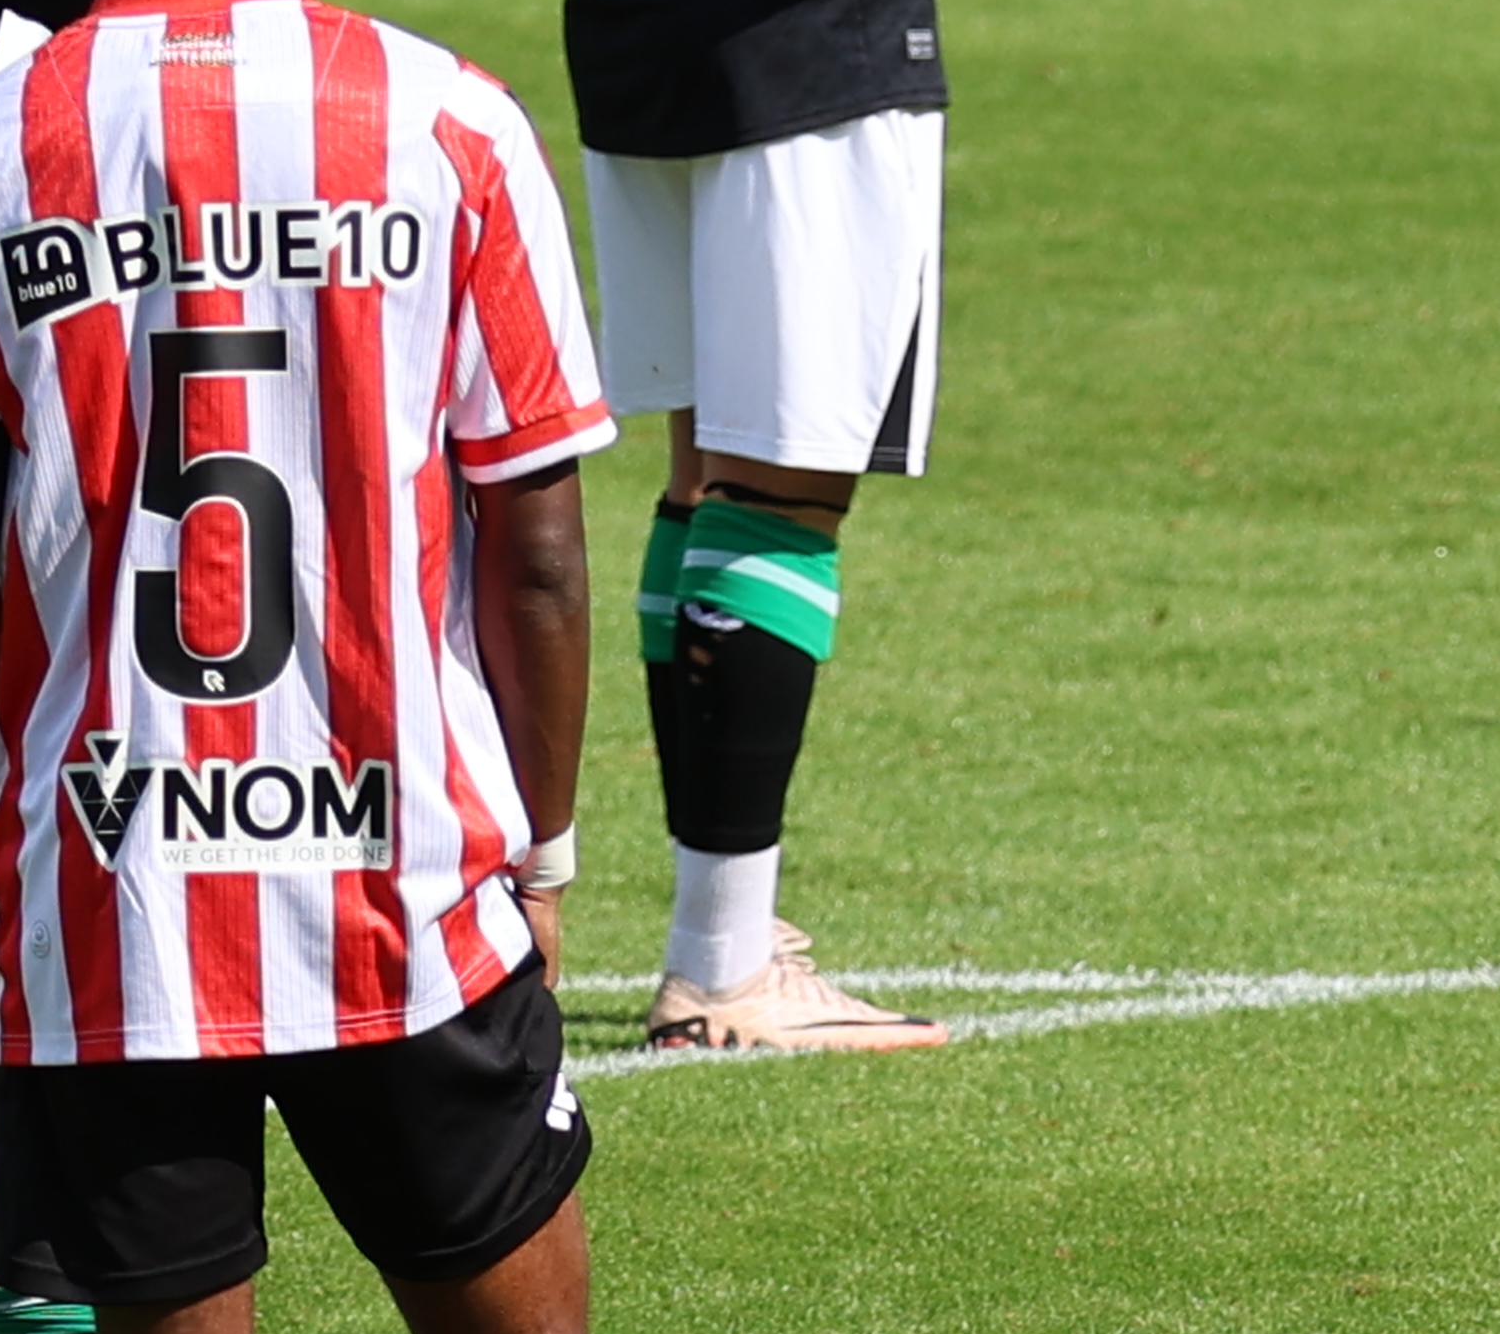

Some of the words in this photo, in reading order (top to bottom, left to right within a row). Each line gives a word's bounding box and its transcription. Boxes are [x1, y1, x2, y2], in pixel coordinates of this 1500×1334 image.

[17, 273, 78, 303] blue10
[103, 208, 422, 295] BLUE10
[132, 328, 297, 704] 5
[162, 763, 388, 842] NOM
[161, 847, 193, 865] WE
[199, 847, 239, 864] GET
[244, 846, 283, 863] THE
[289, 845, 326, 862] JOB
[332, 844, 387, 863] DONE
